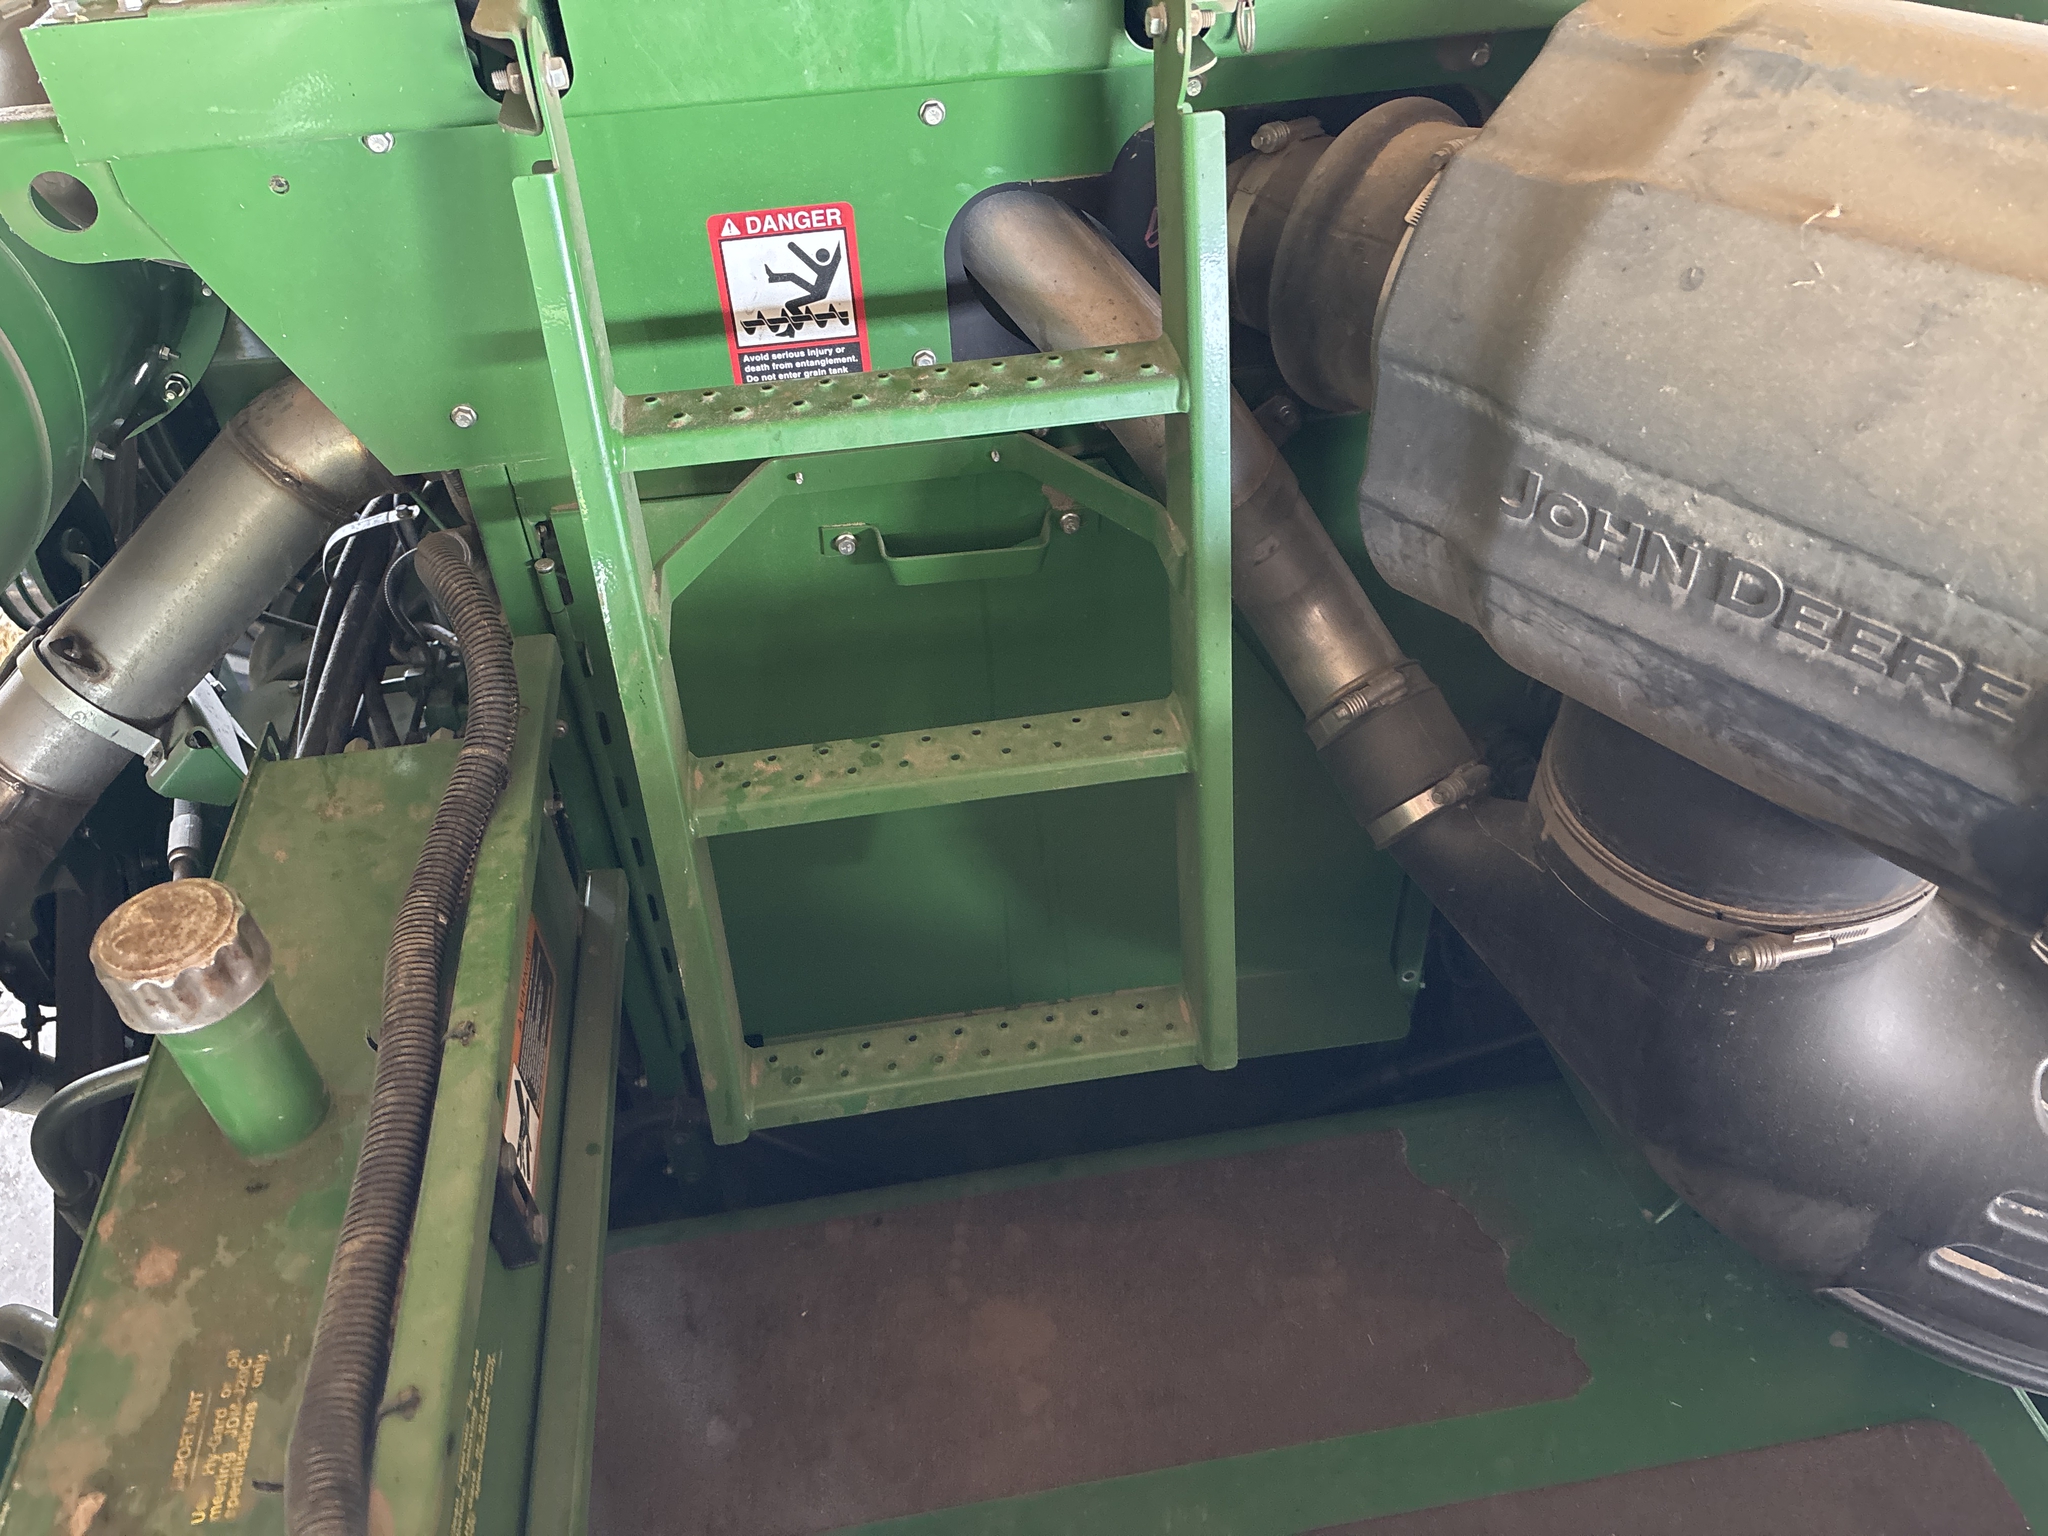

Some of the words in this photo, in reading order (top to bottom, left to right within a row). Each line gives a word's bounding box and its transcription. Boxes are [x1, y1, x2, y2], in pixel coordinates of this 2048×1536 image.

[745, 208, 842, 234] DANGER
[743, 353, 769, 363] Avoid
[771, 350, 805, 360] serious
[807, 348, 833, 358] injury
[835, 346, 845, 354] or
[745, 363, 770, 373] death
[772, 361, 793, 371] from
[795, 355, 858, 367] entanglement.
[746, 374, 759, 383] Do
[761, 373, 776, 381] not
[778, 371, 801, 380] enter
[803, 368, 827, 379] grain
[828, 366, 848, 375] tank
[1500, 469, 1702, 604] JOHN
[1713, 556, 2032, 723] DEERE
[172, 1390, 203, 1492] PORTANT
[224, 1401, 258, 1520] pecifications
